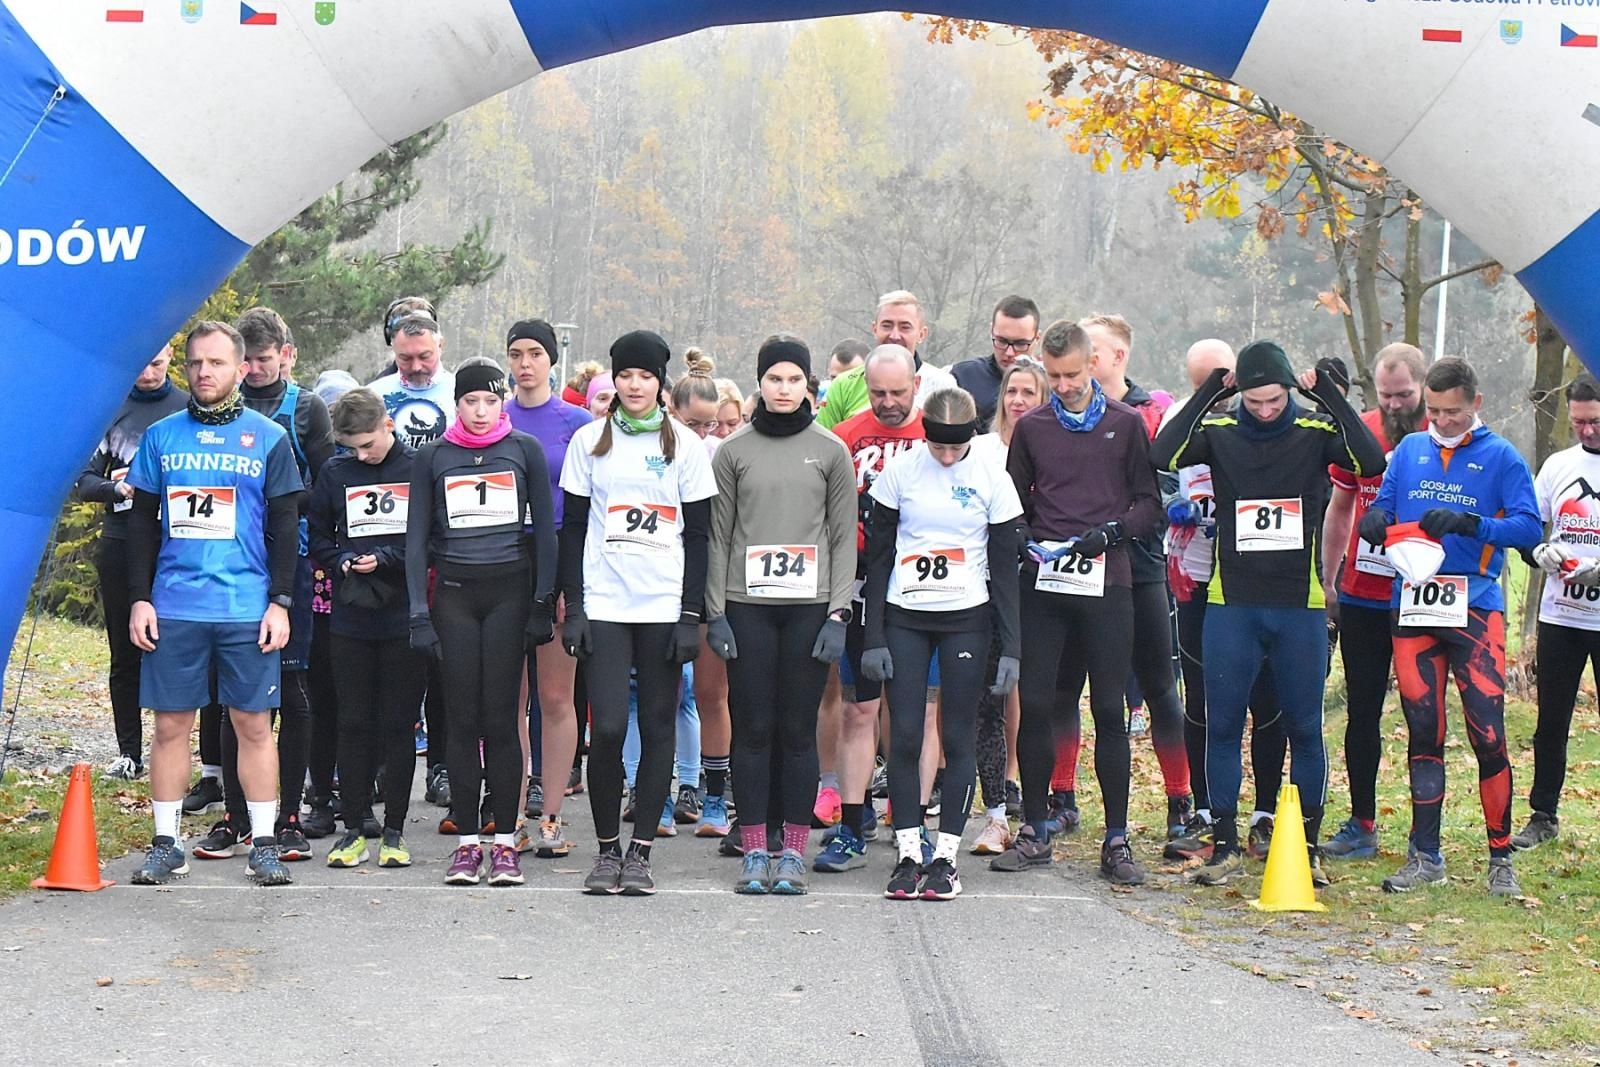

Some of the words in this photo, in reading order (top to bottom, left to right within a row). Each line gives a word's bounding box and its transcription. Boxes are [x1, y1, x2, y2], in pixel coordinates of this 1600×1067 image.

[160, 452, 264, 478] RUNNERS
[474, 481, 487, 505] 1
[1408, 489, 1435, 500] SPORT
[1436, 492, 1477, 507] CENTER
[1420, 479, 1463, 493] GOSŁAW
[186, 493, 214, 518] 14
[363, 490, 396, 515] 36
[626, 508, 659, 534] 94
[1255, 506, 1283, 530] 81
[760, 552, 806, 577] 134
[916, 555, 949, 582] 98
[1052, 551, 1093, 575] 126
[1411, 581, 1456, 606] 108
